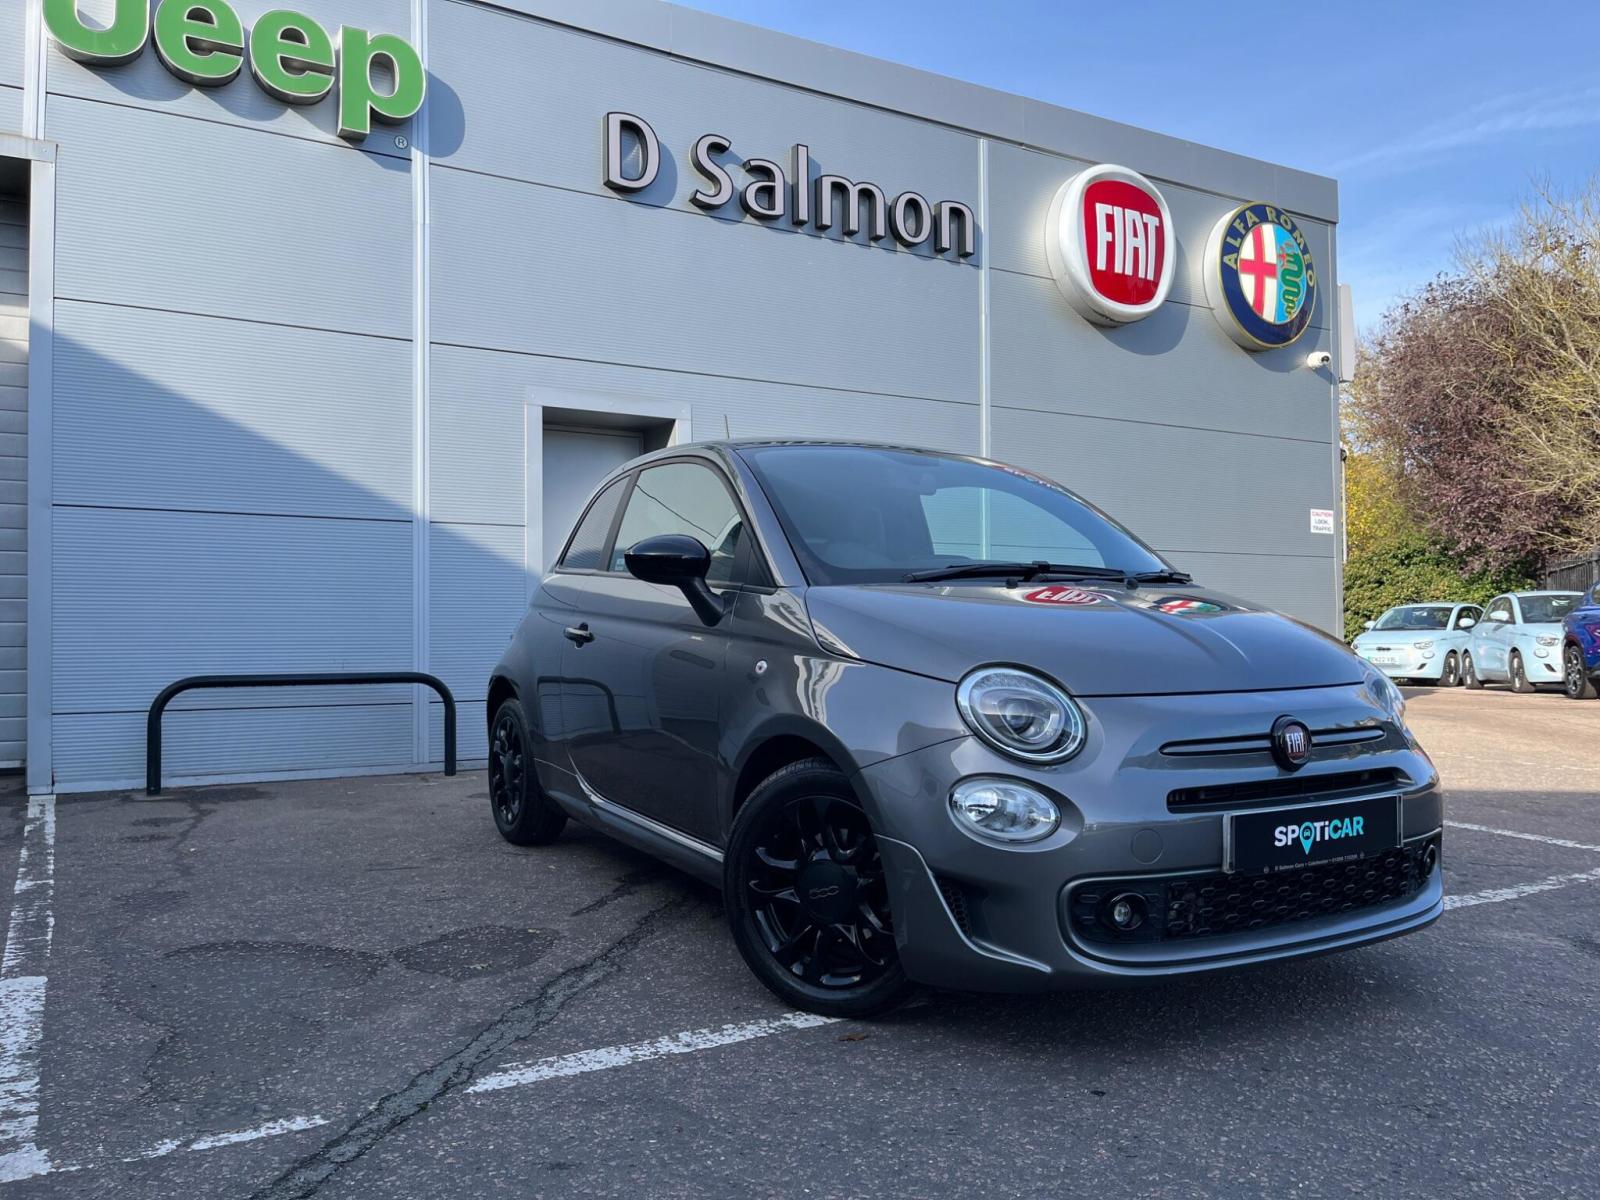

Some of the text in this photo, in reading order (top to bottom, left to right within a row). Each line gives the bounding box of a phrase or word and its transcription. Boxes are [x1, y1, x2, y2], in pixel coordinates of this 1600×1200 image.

[603, 112, 975, 258] D Salmon
[1095, 202, 1160, 281] FIAT
[1223, 206, 1315, 288] ALFA ROMEO
[1286, 732, 1304, 753] FIAT
